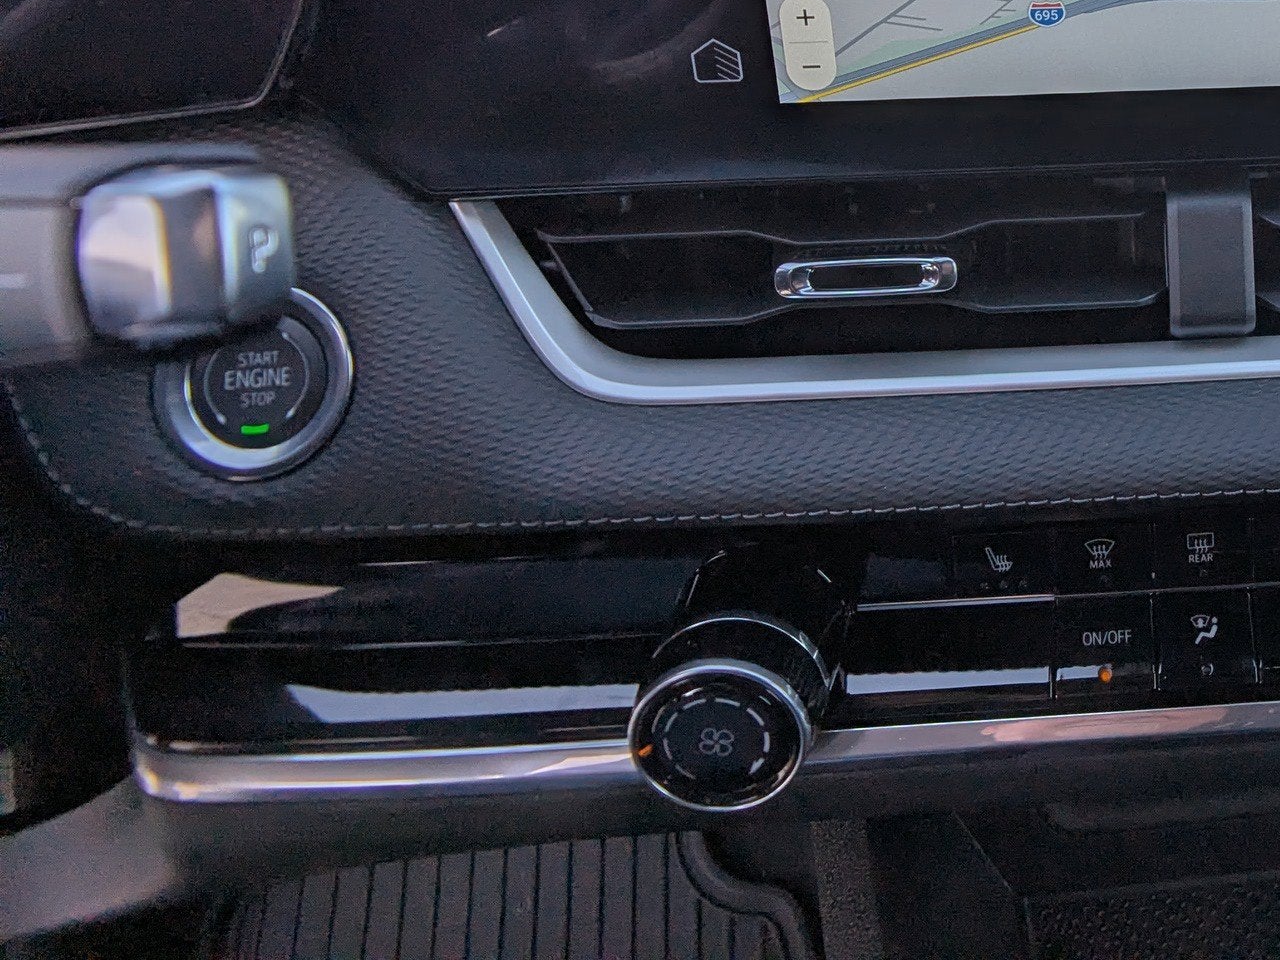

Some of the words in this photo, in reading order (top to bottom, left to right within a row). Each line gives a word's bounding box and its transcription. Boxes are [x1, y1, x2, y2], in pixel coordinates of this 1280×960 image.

[1034, 9, 1059, 22] 695
[237, 351, 280, 368] START
[223, 368, 291, 390] ENGINE
[239, 391, 277, 409] STOP
[1089, 558, 1112, 570] MAX
[1188, 553, 1214, 564] REAR
[1082, 628, 1132, 646] ON/OFF
